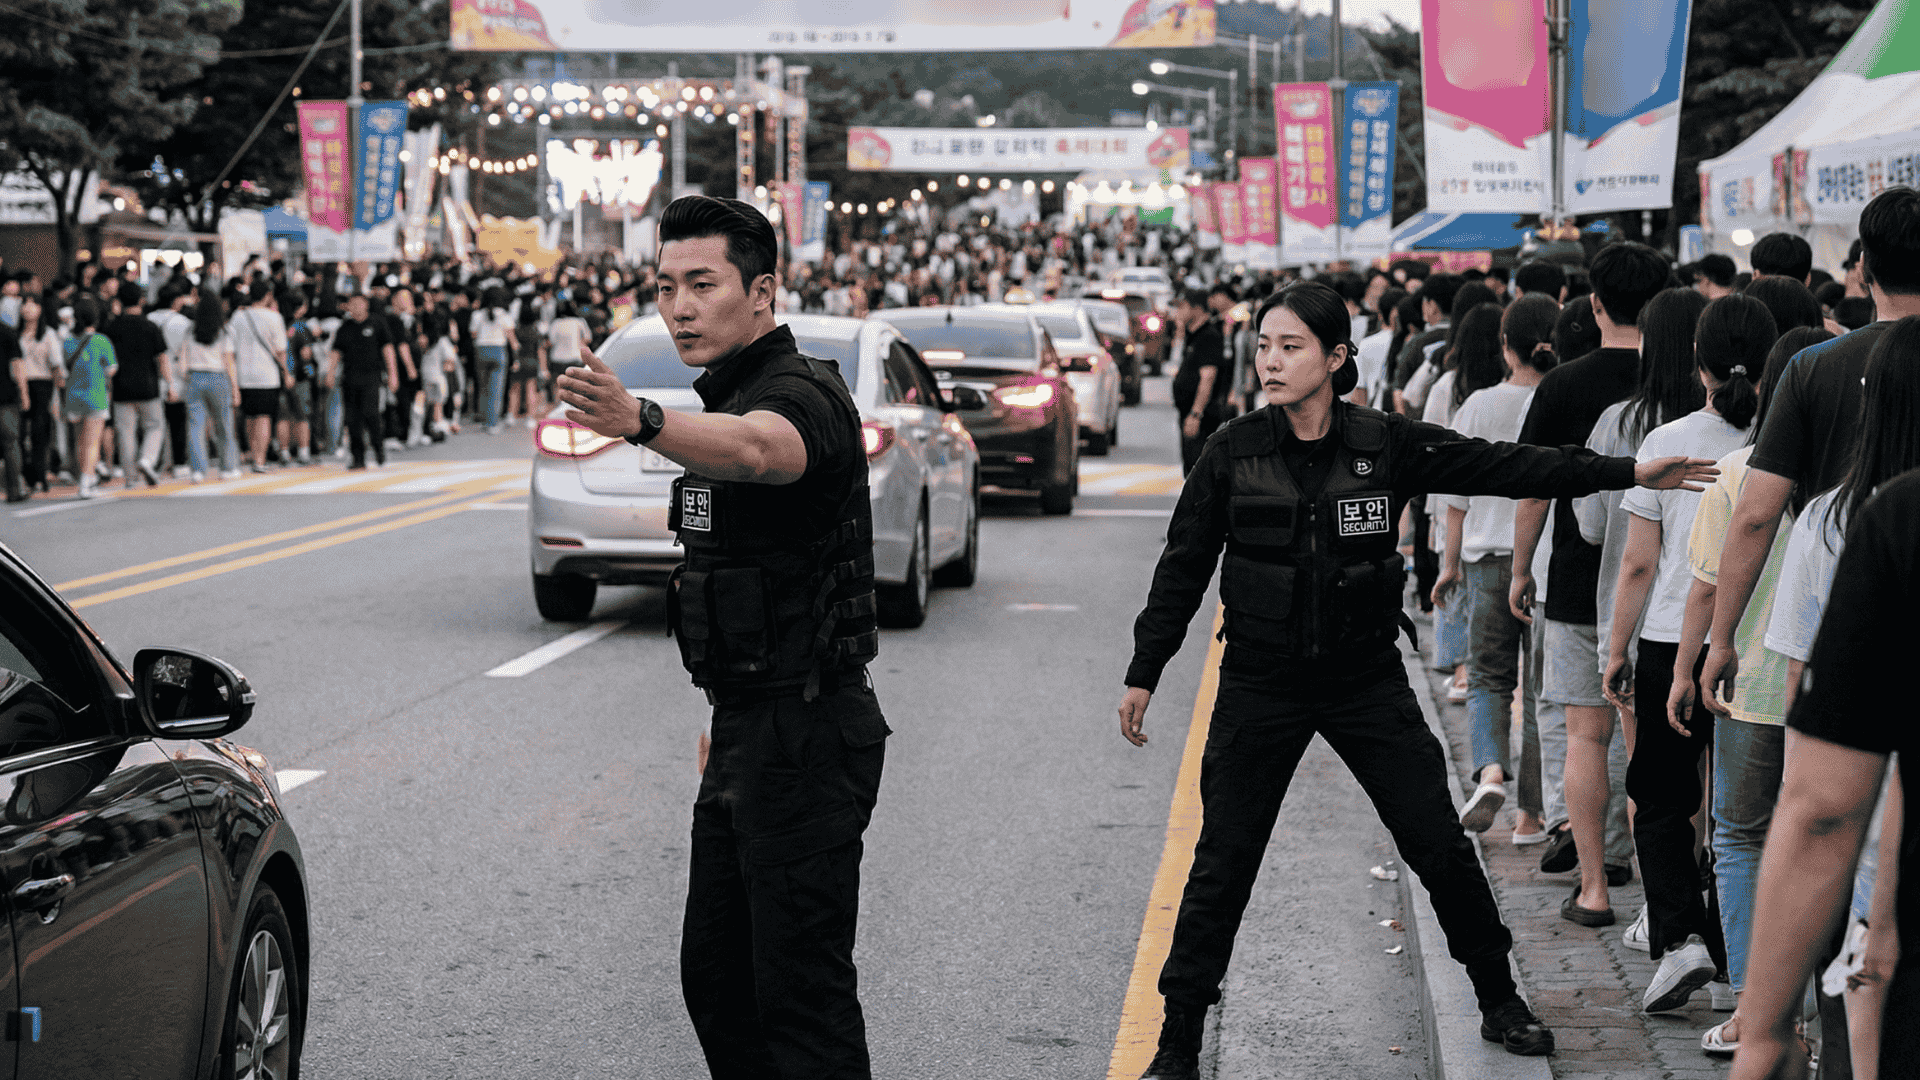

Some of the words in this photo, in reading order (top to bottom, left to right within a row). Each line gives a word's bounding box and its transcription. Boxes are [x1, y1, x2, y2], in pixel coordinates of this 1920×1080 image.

[685, 492, 708, 515] 보안
[1344, 500, 1384, 521] 보안
[1343, 520, 1385, 533] SECURITY
